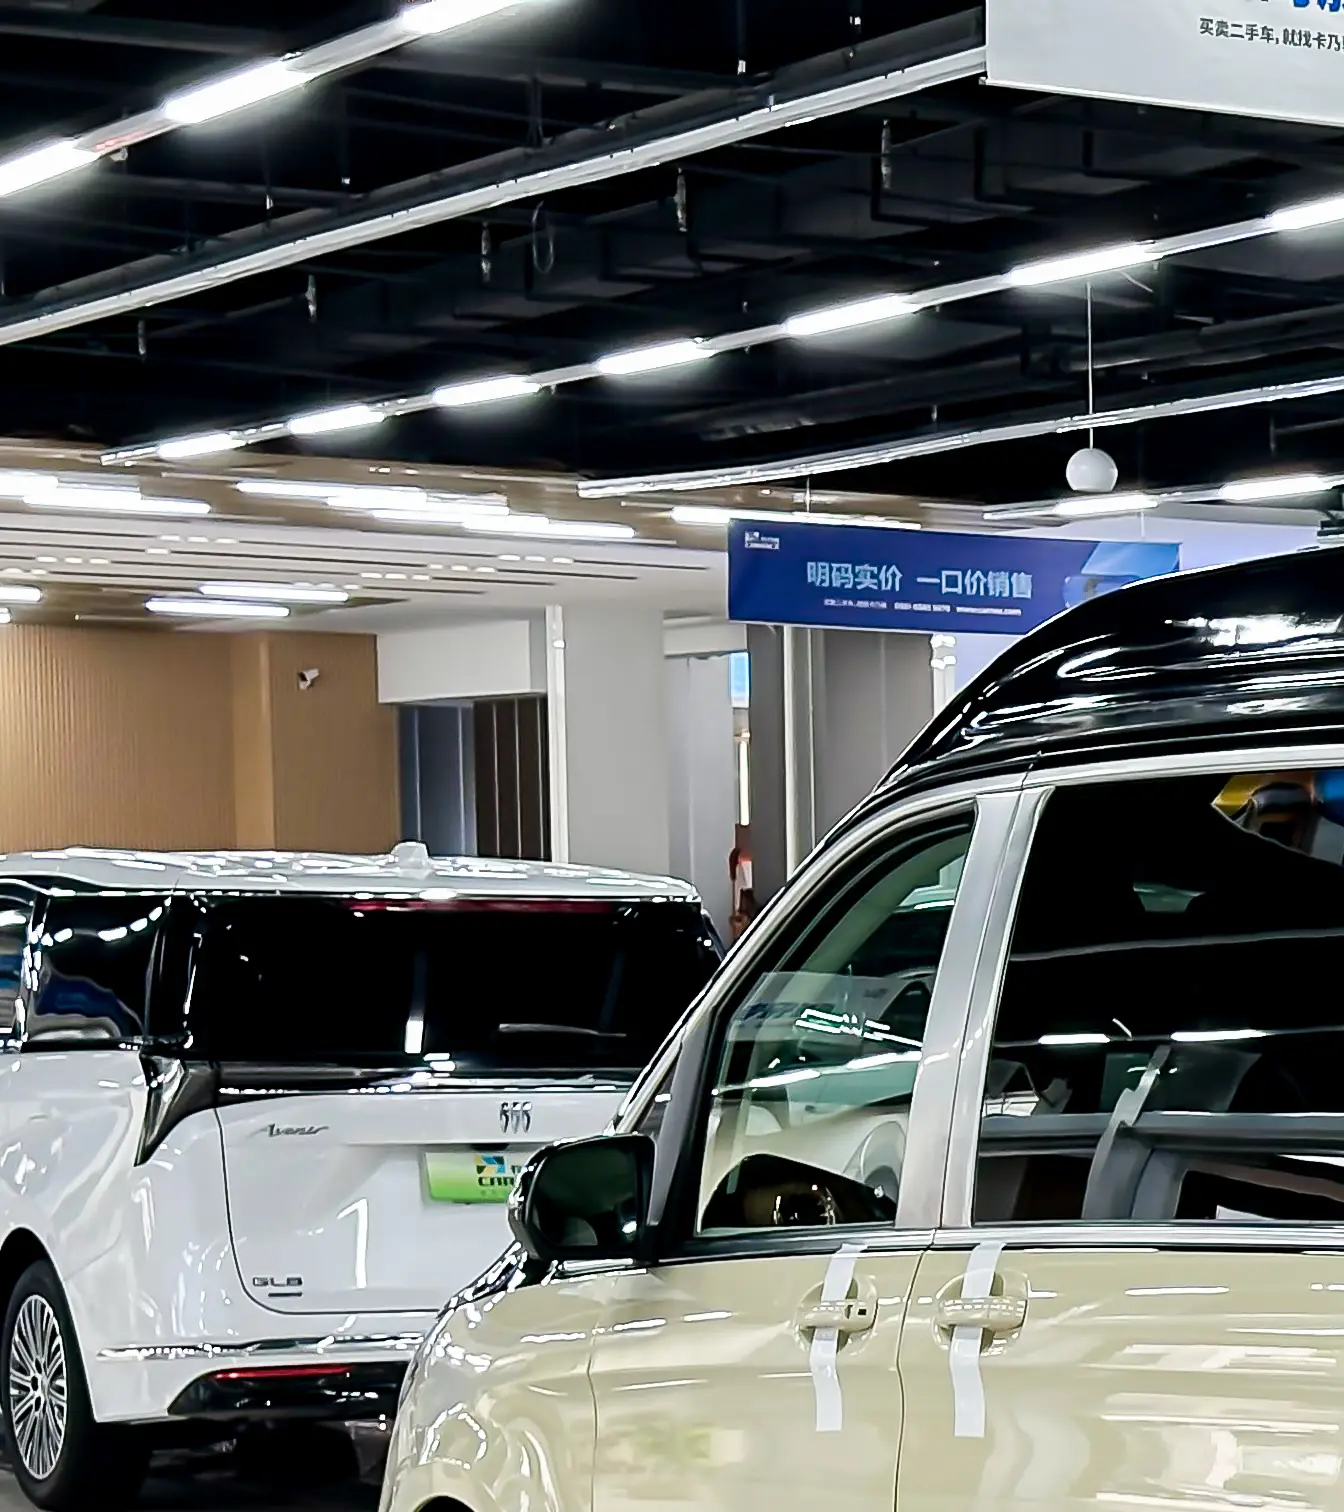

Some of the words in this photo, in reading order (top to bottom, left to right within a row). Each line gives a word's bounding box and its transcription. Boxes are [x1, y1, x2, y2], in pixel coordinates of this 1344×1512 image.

[806, 561, 903, 592] 明码实价
[916, 568, 1033, 599] 一口价销售
